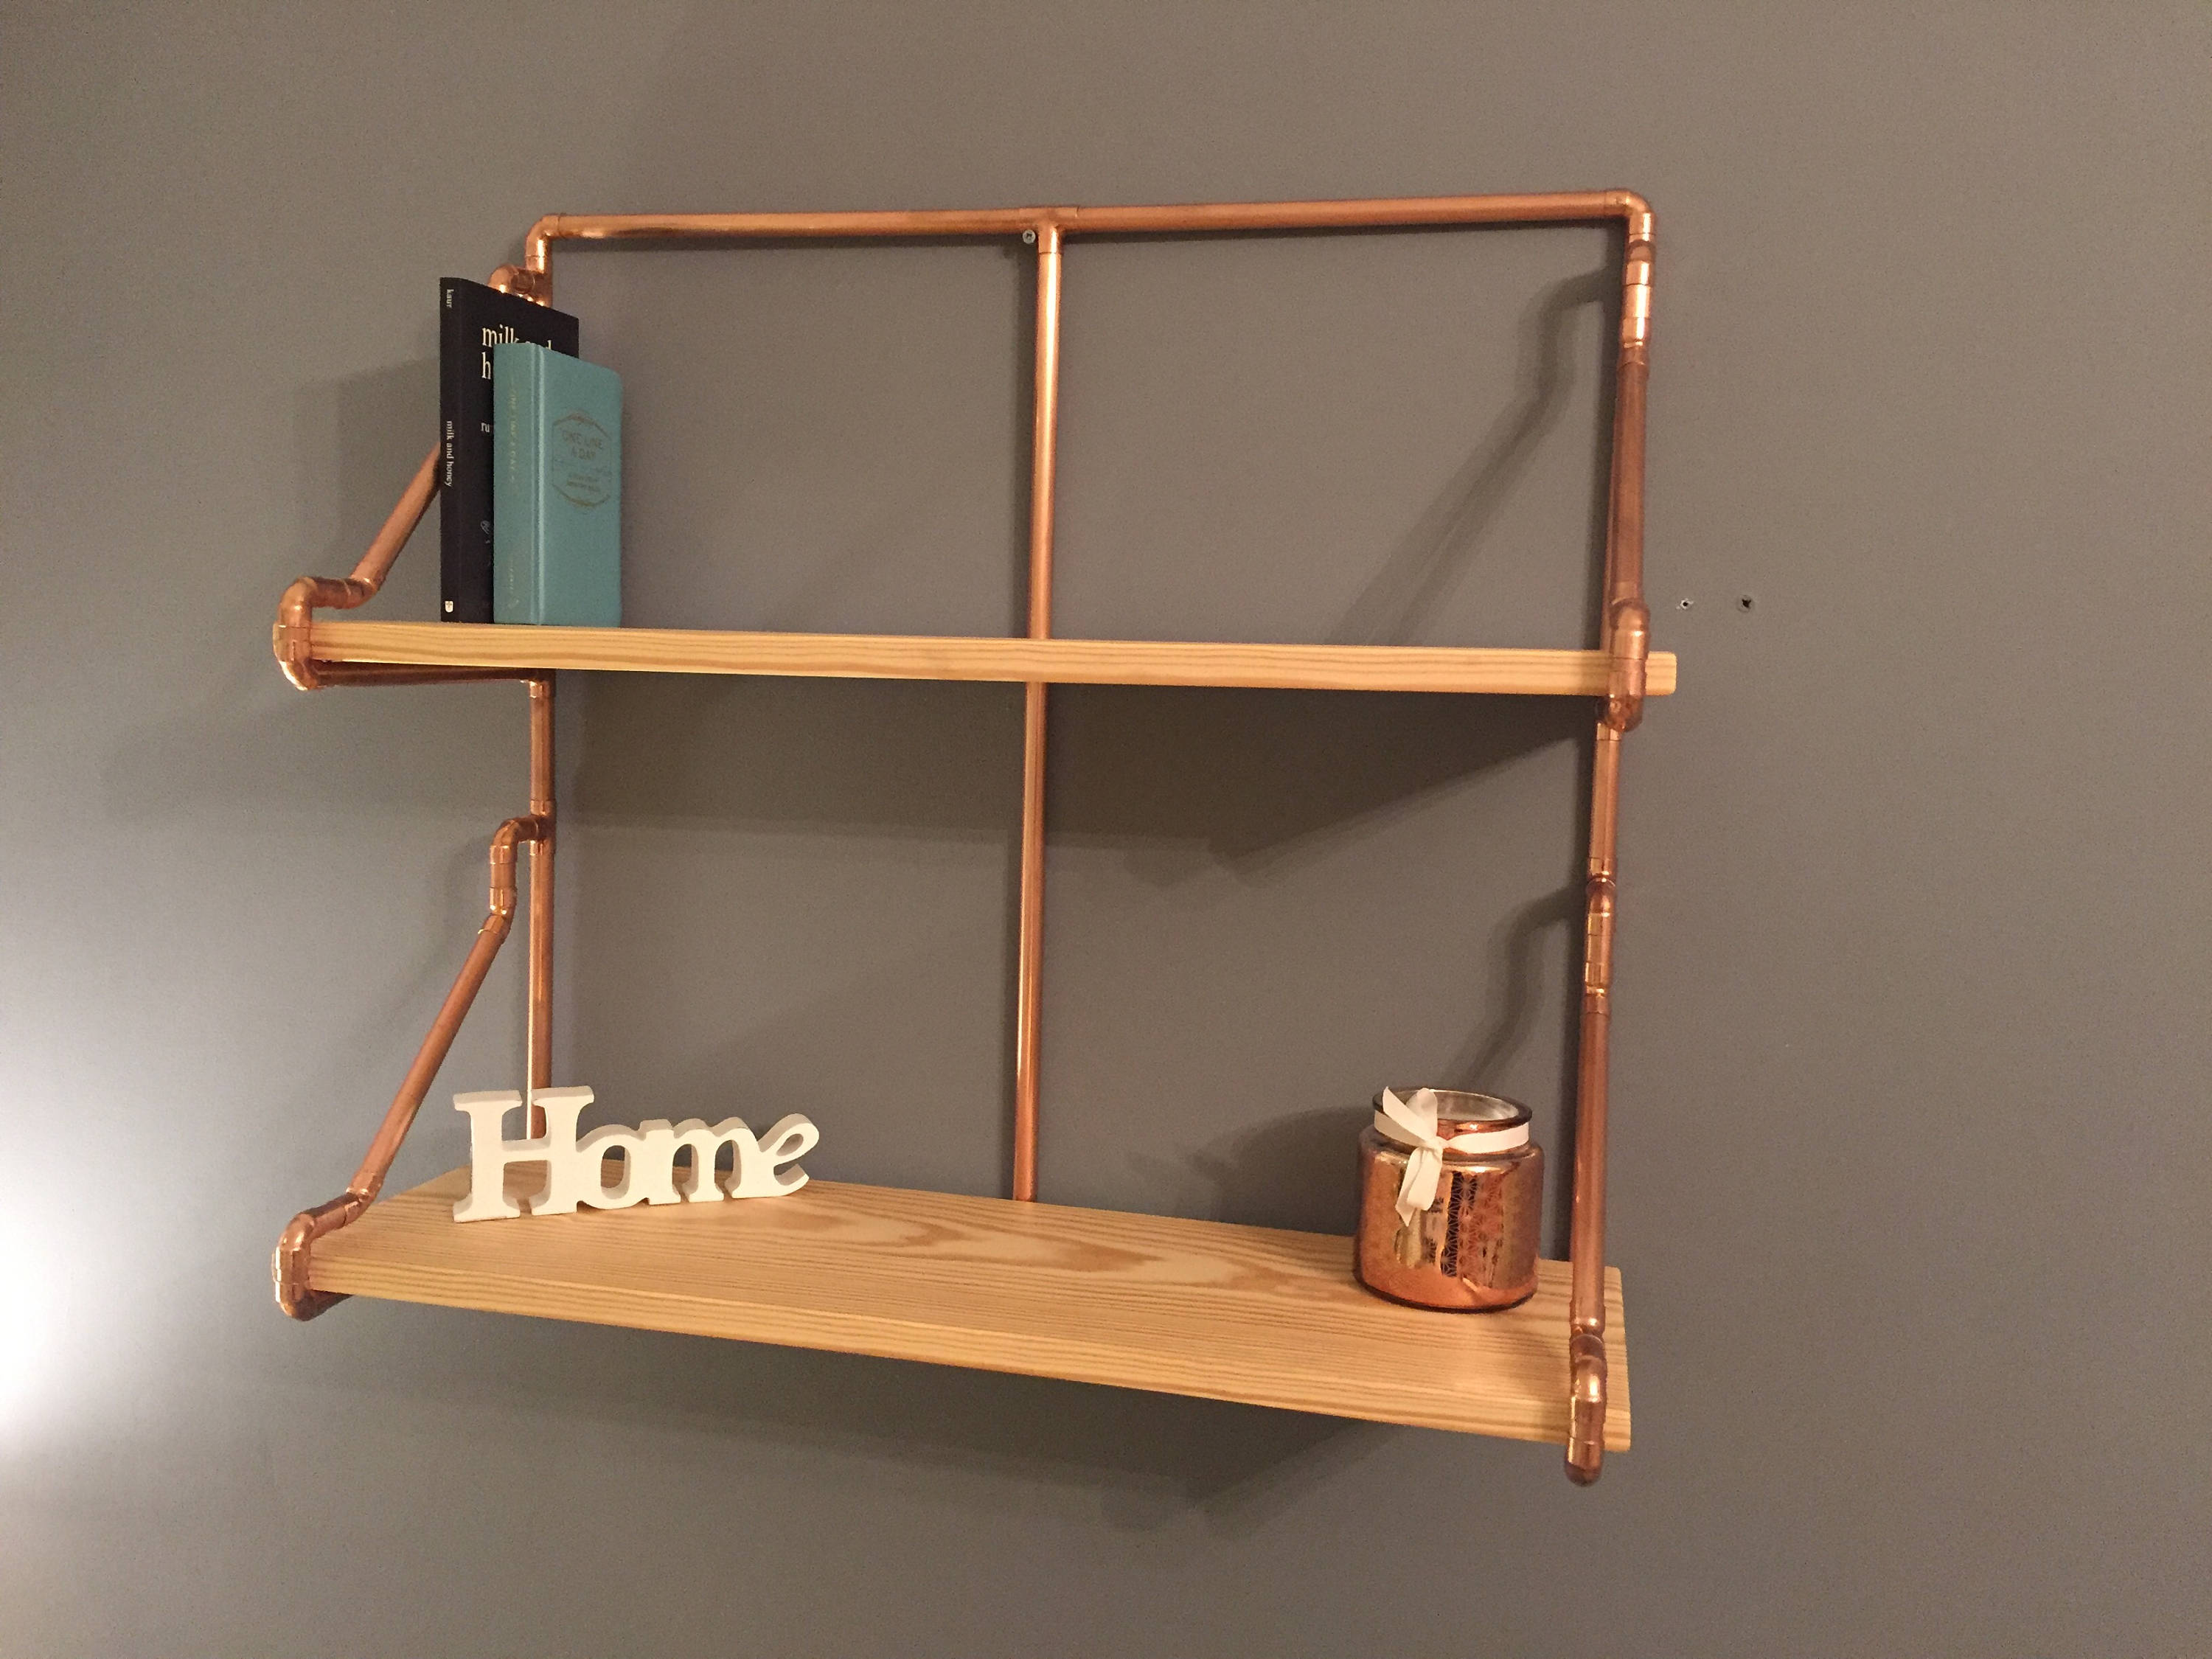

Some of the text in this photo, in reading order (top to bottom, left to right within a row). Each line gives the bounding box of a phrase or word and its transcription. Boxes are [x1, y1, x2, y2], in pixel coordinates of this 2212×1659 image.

[446, 288, 455, 308] kaur
[444, 420, 455, 487] milk and honey
[453, 1085, 819, 1222] Home
